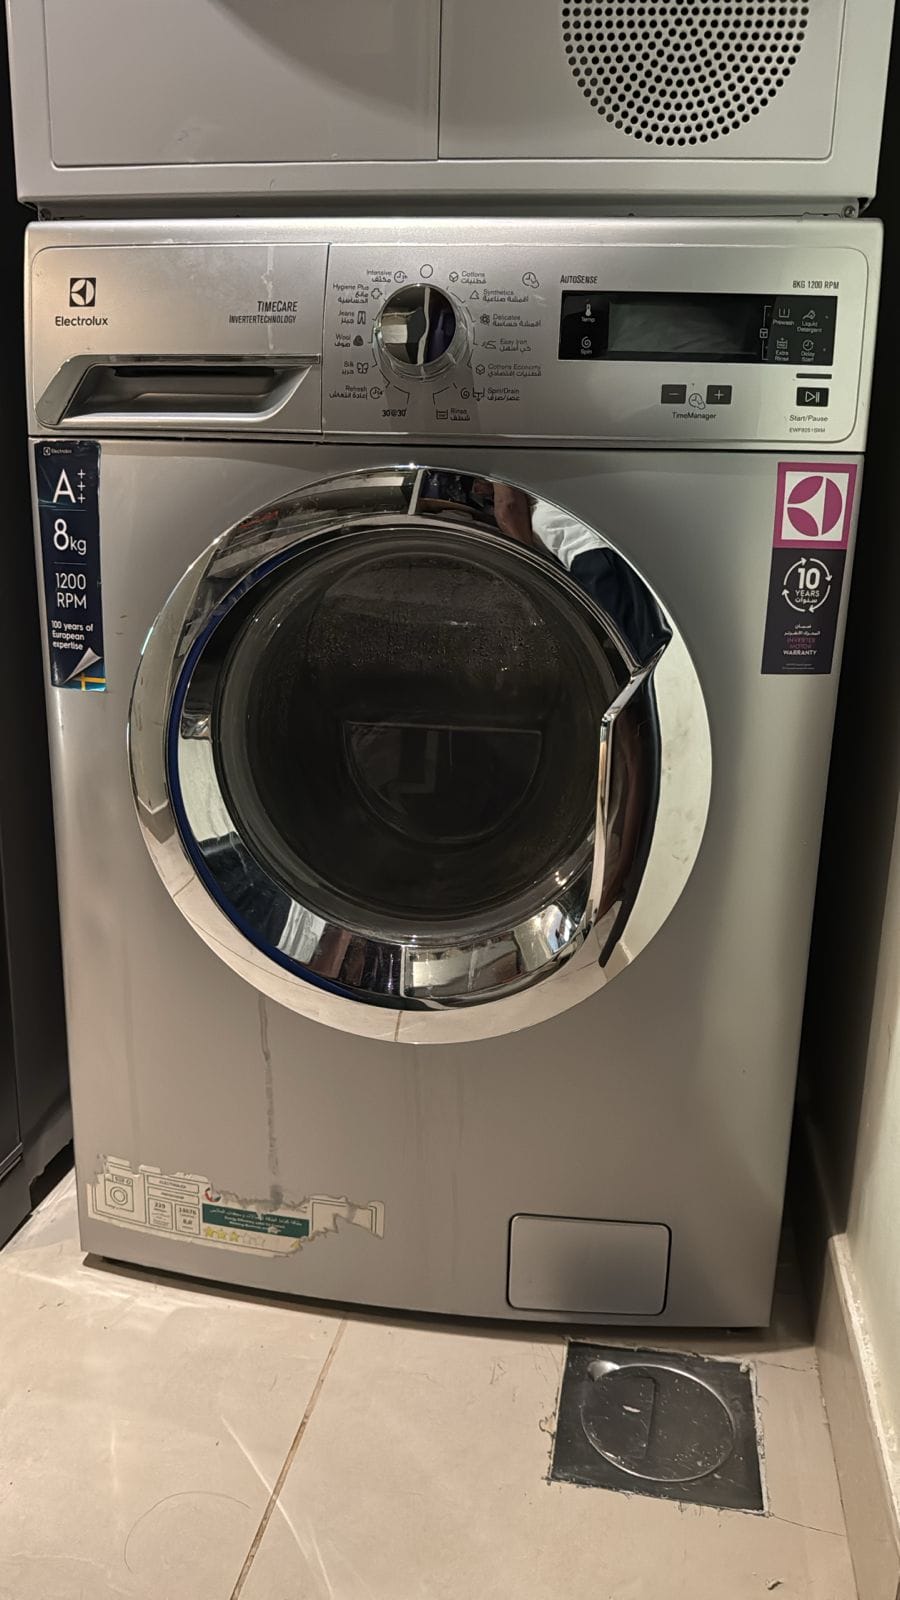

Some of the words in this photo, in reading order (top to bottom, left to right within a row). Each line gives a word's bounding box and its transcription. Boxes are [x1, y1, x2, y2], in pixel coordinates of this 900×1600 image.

[333, 284, 356, 292] Hygiene
[792, 280, 805, 289] 8KG
[808, 280, 823, 289] 1200
[824, 281, 840, 289] RPM
[55, 315, 109, 327] Electrolux
[580, 348, 593, 356] Spin
[487, 363, 512, 371] Cottons
[513, 363, 542, 371] Economy
[487, 387, 520, 395] Spin/Drain
[672, 411, 717, 421] TimeManager
[789, 414, 829, 422] Start/Pause
[55, 572, 87, 590] 1200
[797, 567, 820, 590] 10
[795, 589, 820, 597] YEARS
[56, 592, 87, 609] RPM
[51, 620, 62, 629] 100
[63, 623, 84, 632] years
[85, 624, 94, 632] of
[52, 630, 85, 641] European
[52, 641, 84, 651] expertise
